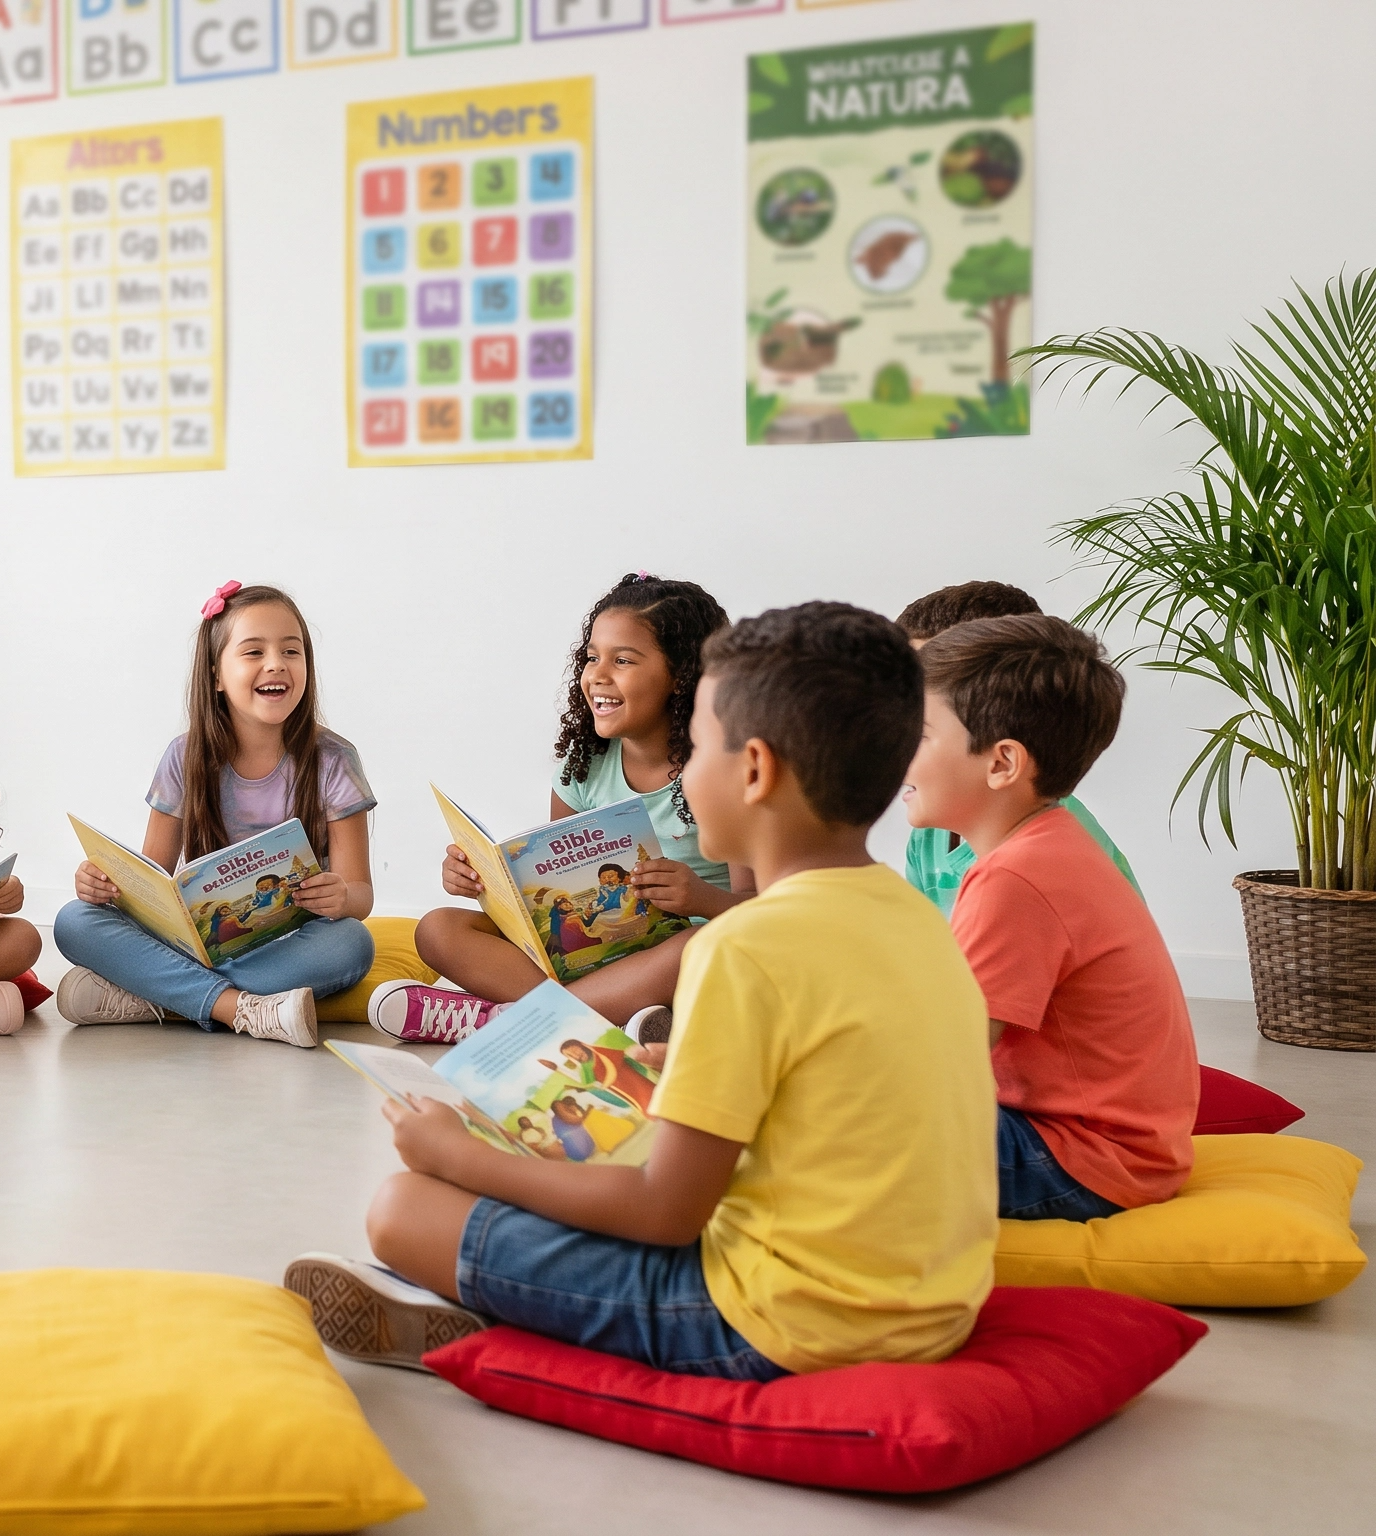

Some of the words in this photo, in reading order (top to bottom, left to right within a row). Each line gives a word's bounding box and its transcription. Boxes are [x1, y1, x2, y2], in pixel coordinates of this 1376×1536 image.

[306, 0, 379, 54] Dd
[428, 0, 499, 40] Ee
[83, 33, 148, 81] Bb
[192, 18, 258, 67] Cc
[952, 46, 971, 68] A
[807, 73, 972, 123] NATURA
[378, 103, 559, 147] Numbers
[72, 188, 107, 215] Bb
[119, 182, 156, 210] Cc
[169, 178, 208, 204] Dd
[431, 170, 448, 197] 2
[487, 165, 504, 192] 3
[541, 161, 562, 184] 4
[25, 240, 58, 266] Ee
[120, 231, 159, 261] Gg
[169, 229, 206, 251] Hh
[375, 232, 392, 259] 5
[429, 229, 448, 255] 6
[488, 224, 503, 250] 7
[171, 279, 207, 298] Nn
[483, 282, 508, 310] 15
[538, 278, 565, 306] 16
[25, 334, 60, 363] Pp
[122, 328, 153, 351] Rr
[372, 348, 397, 374] 17
[427, 345, 452, 372] 18
[532, 338, 570, 366] 20
[73, 379, 110, 404] Uu
[123, 378, 157, 401] Vv
[170, 375, 208, 396] Ww
[533, 397, 570, 425] 20
[124, 425, 158, 453] Yy
[173, 420, 207, 447] Zz
[548, 828, 605, 856] Bible
